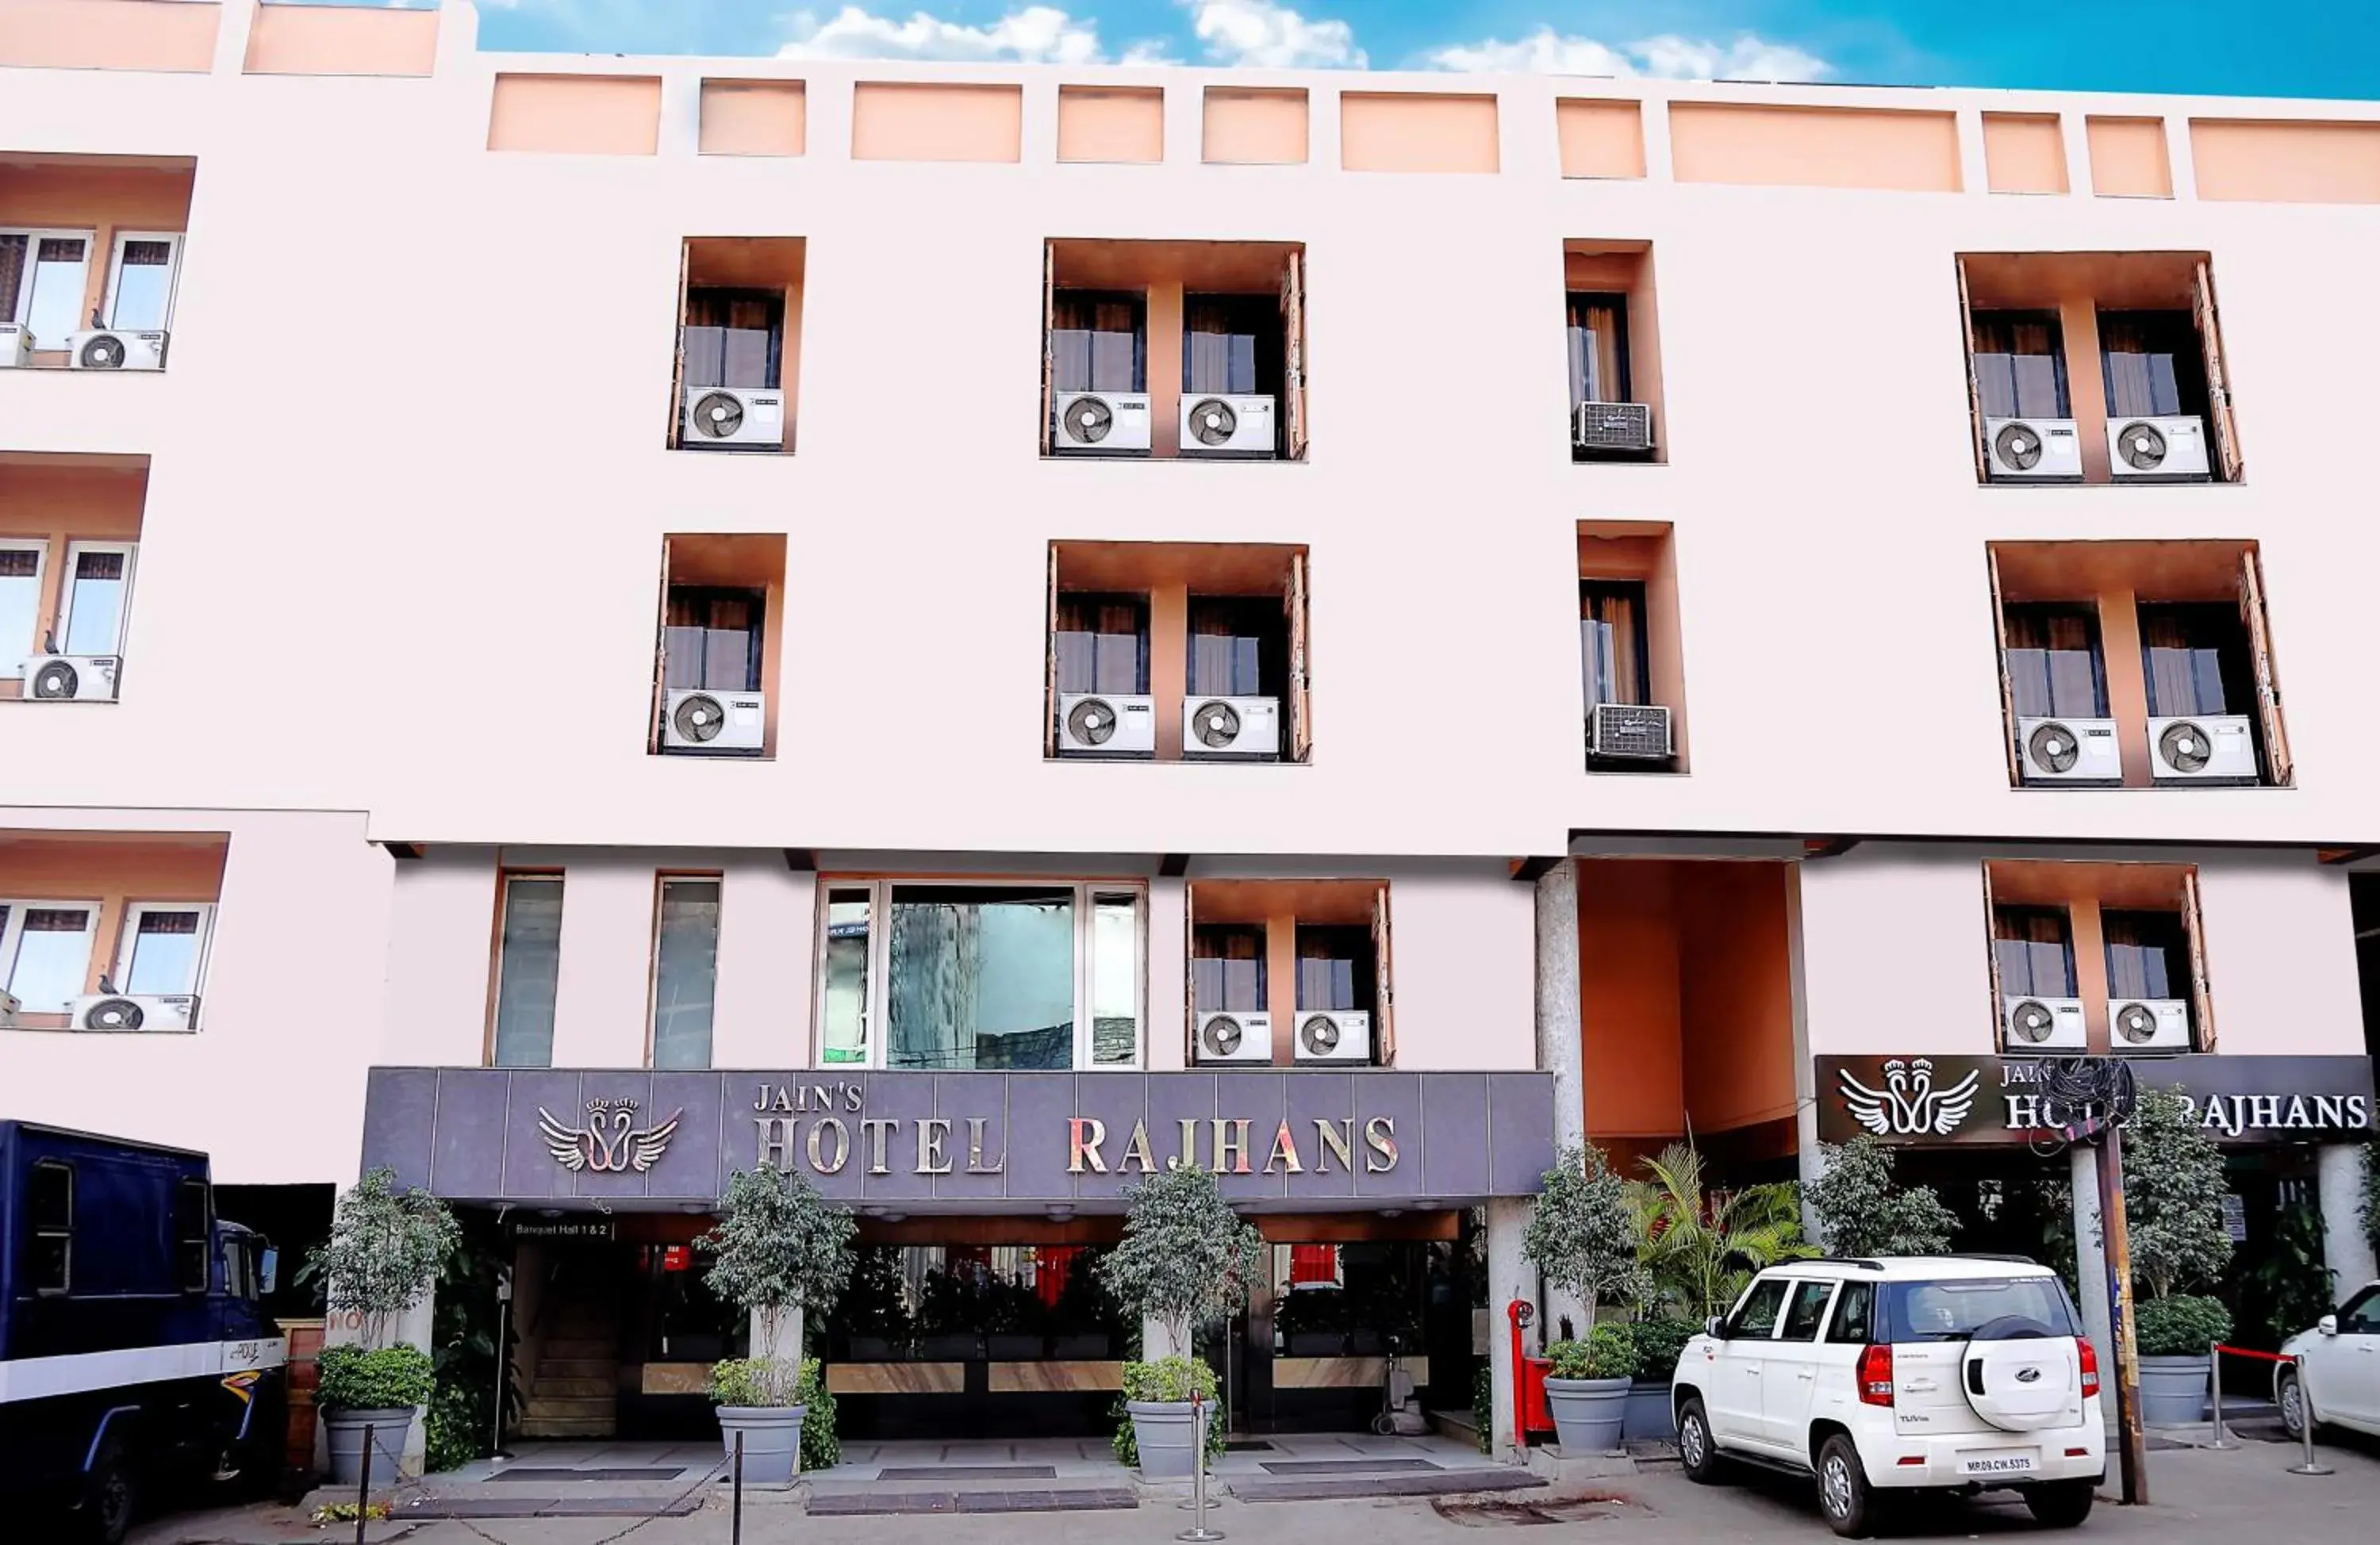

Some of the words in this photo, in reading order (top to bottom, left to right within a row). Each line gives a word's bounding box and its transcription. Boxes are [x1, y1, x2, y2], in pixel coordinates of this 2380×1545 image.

[754, 1081, 862, 1111] JAIN'S
[2179, 1095, 2367, 1137] RAJHANS
[753, 1117, 1004, 1175] HOTEL
[1065, 1117, 1399, 1174] RAJHANS
[516, 1224, 556, 1236] Banquet
[559, 1224, 578, 1235] Hall
[589, 1225, 597, 1235] &
[599, 1225, 607, 1235] 2
